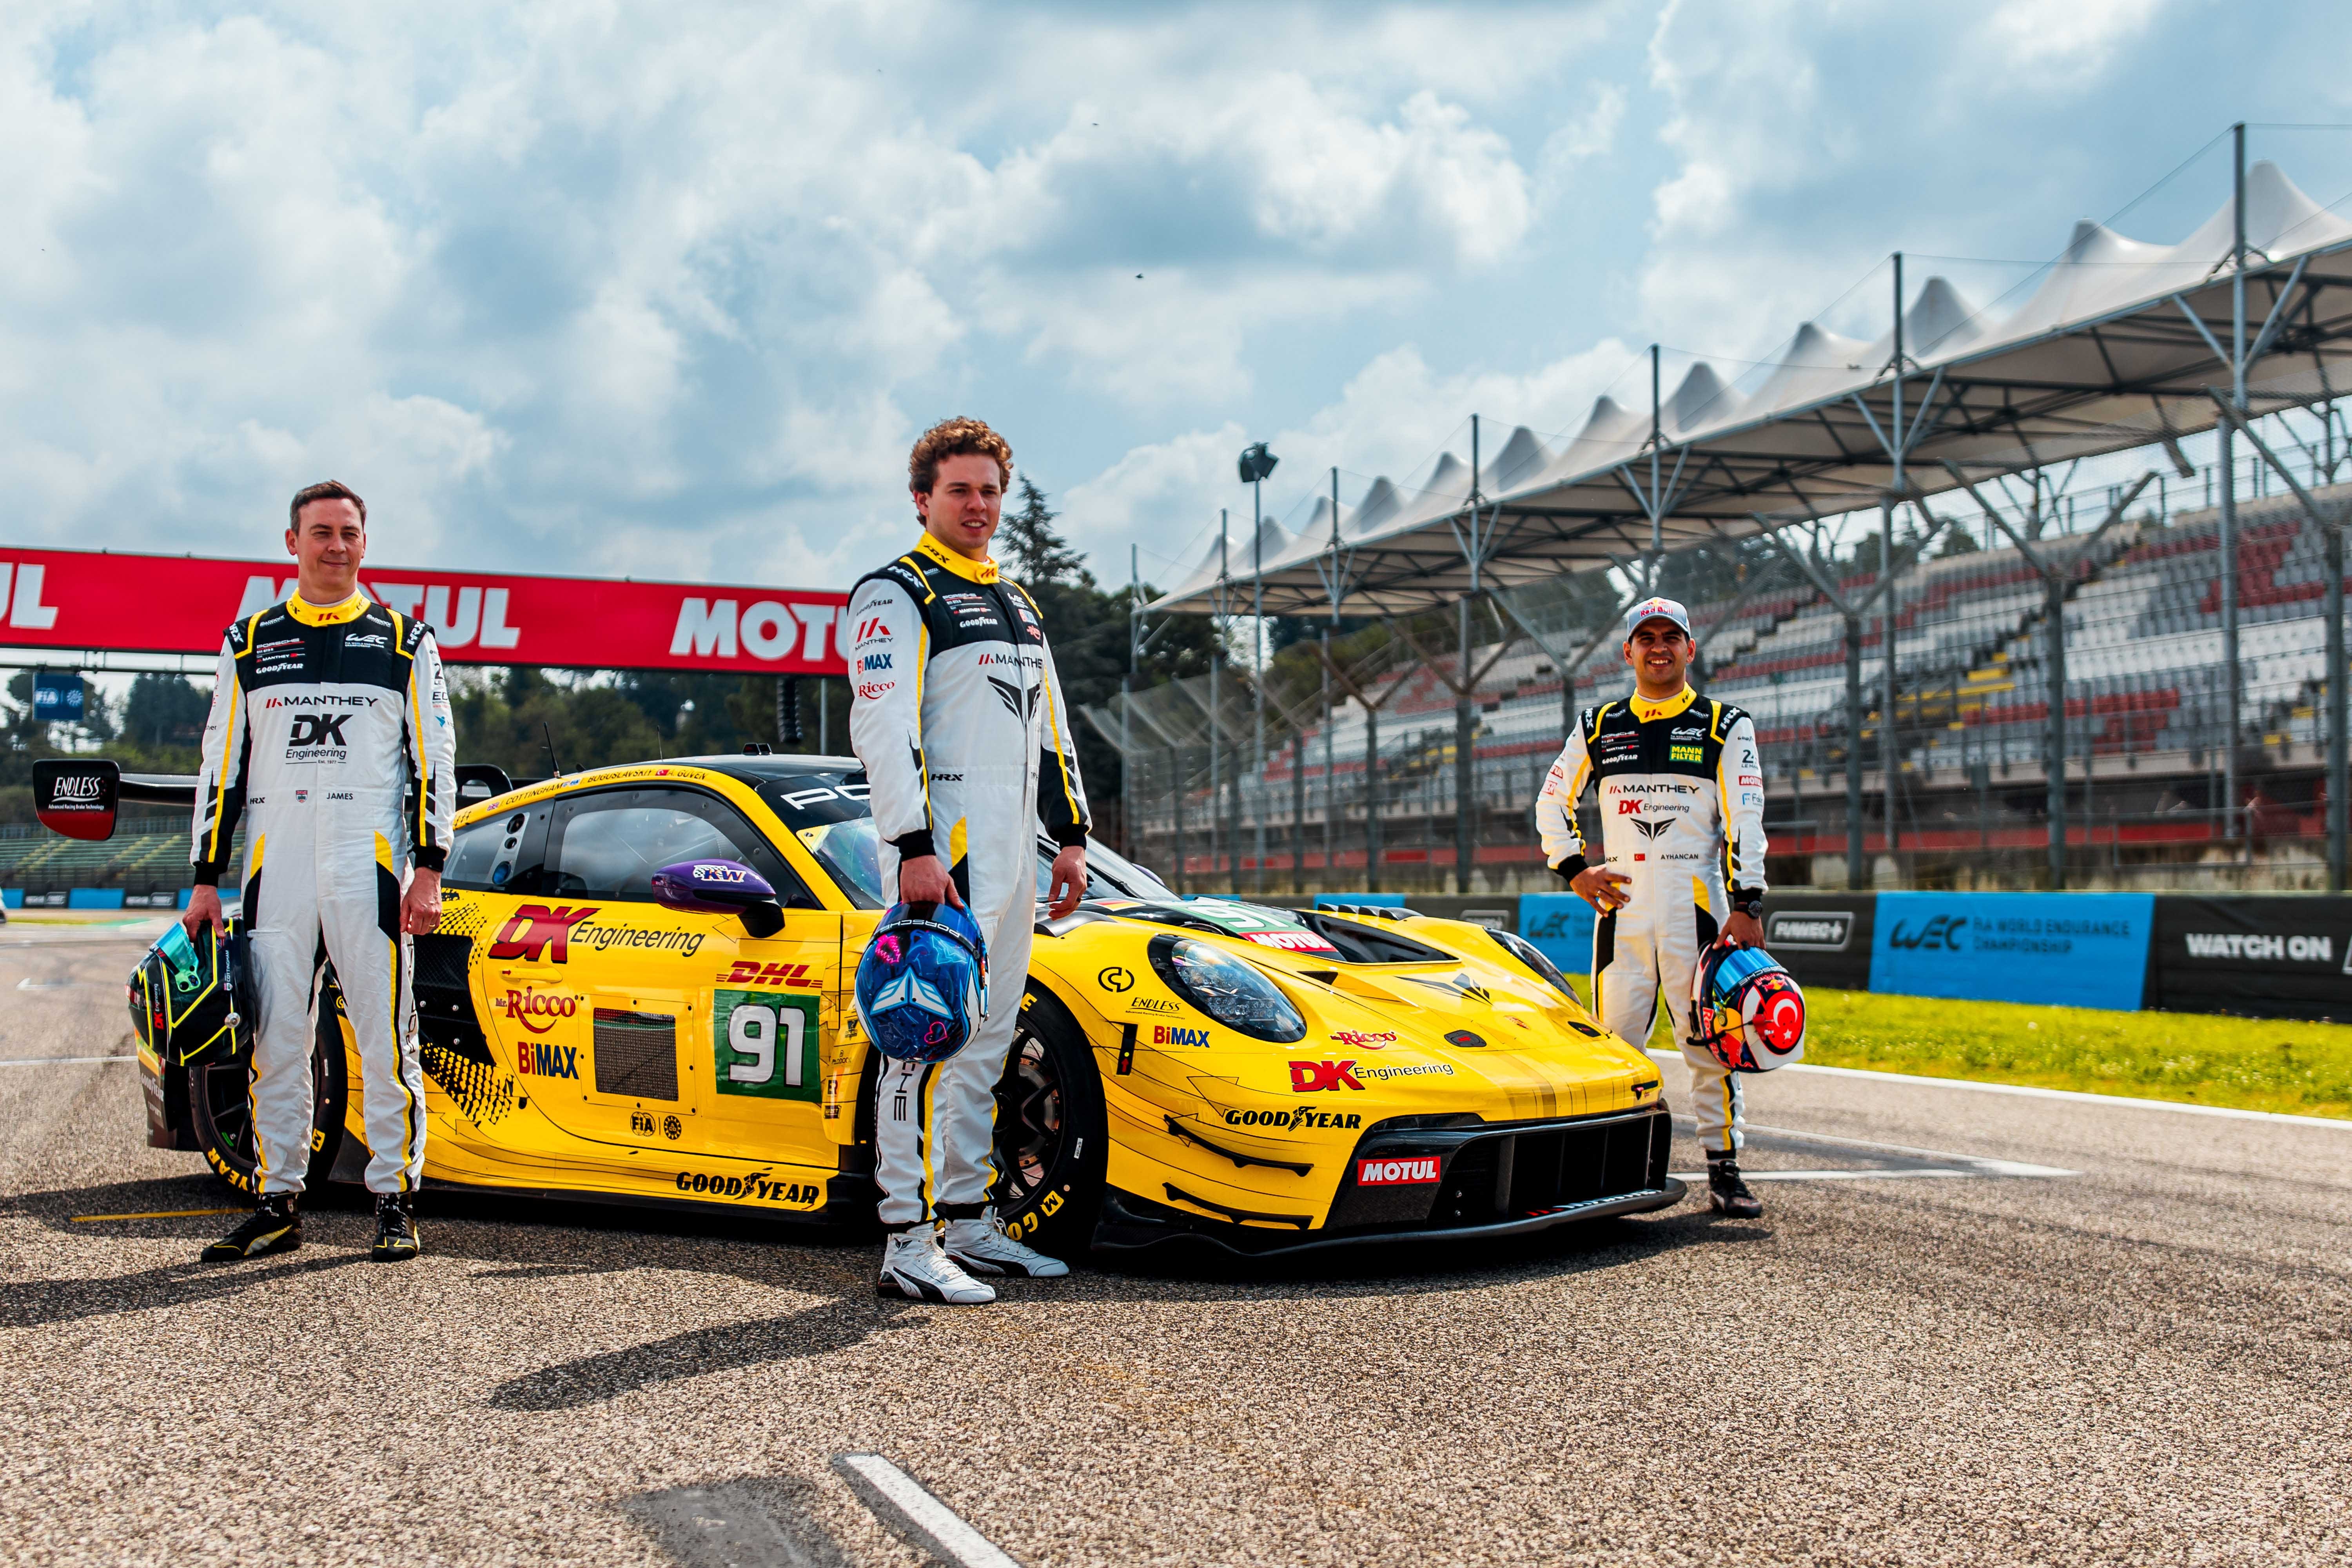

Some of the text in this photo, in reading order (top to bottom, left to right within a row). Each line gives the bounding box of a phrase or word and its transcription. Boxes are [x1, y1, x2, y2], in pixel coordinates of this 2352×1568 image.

[887, 566, 924, 587] HRX
[1640, 606, 1673, 617] Red Bull
[668, 597, 848, 662] MOT
[960, 617, 998, 628] GOODYEAR
[345, 633, 388, 644] WEC
[407, 621, 425, 645] HRX
[257, 638, 300, 649] PORSCHE
[855, 637, 893, 652] MANTHEY
[256, 663, 303, 674] GOODYEAR
[857, 653, 893, 675] BiMAX
[996, 653, 1043, 669] MANTHE
[858, 681, 895, 700] Ricco
[284, 695, 378, 707] MANTHEY
[1720, 707, 1740, 730] HRX
[289, 713, 353, 746] DK
[1671, 727, 1706, 737] WEC
[286, 748, 347, 760] Engineering
[1602, 754, 1638, 764] GOODYEAR
[1671, 746, 1702, 755] MANN
[1671, 753, 1701, 762] FILTER
[54, 777, 101, 796] ENDLESS
[931, 773, 964, 782] HRX
[506, 783, 564, 804] COTTINGHAM
[1623, 784, 1700, 794] MANTHEY
[1618, 799, 1690, 814] DK Engineering
[704, 869, 744, 881] KW
[1188, 906, 1290, 928] 91
[488, 904, 706, 964] DK Engineering
[880, 919, 960, 938] PORSCHE
[1889, 914, 1967, 950] WEC
[2046, 919, 2130, 936] ENDURANCE
[1249, 933, 1333, 949] MOTUL
[2185, 933, 2332, 962] WATCH ON
[727, 960, 812, 987] DHL
[495, 985, 577, 1034] Mr. Ricco
[1131, 997, 1181, 1011] ENDLESS
[154, 1012, 164, 1030] DK
[728, 1003, 806, 1088] 91
[1154, 1025, 1210, 1048] BiMAX
[1336, 1030, 1397, 1050] Ricco
[518, 1041, 579, 1080] BiMAX
[1288, 1060, 1454, 1093] DK Engineering
[1225, 1106, 1361, 1132] GOODYEAR
[1362, 1160, 1437, 1181] MOTUL
[676, 1172, 820, 1204] GOODYEAR
